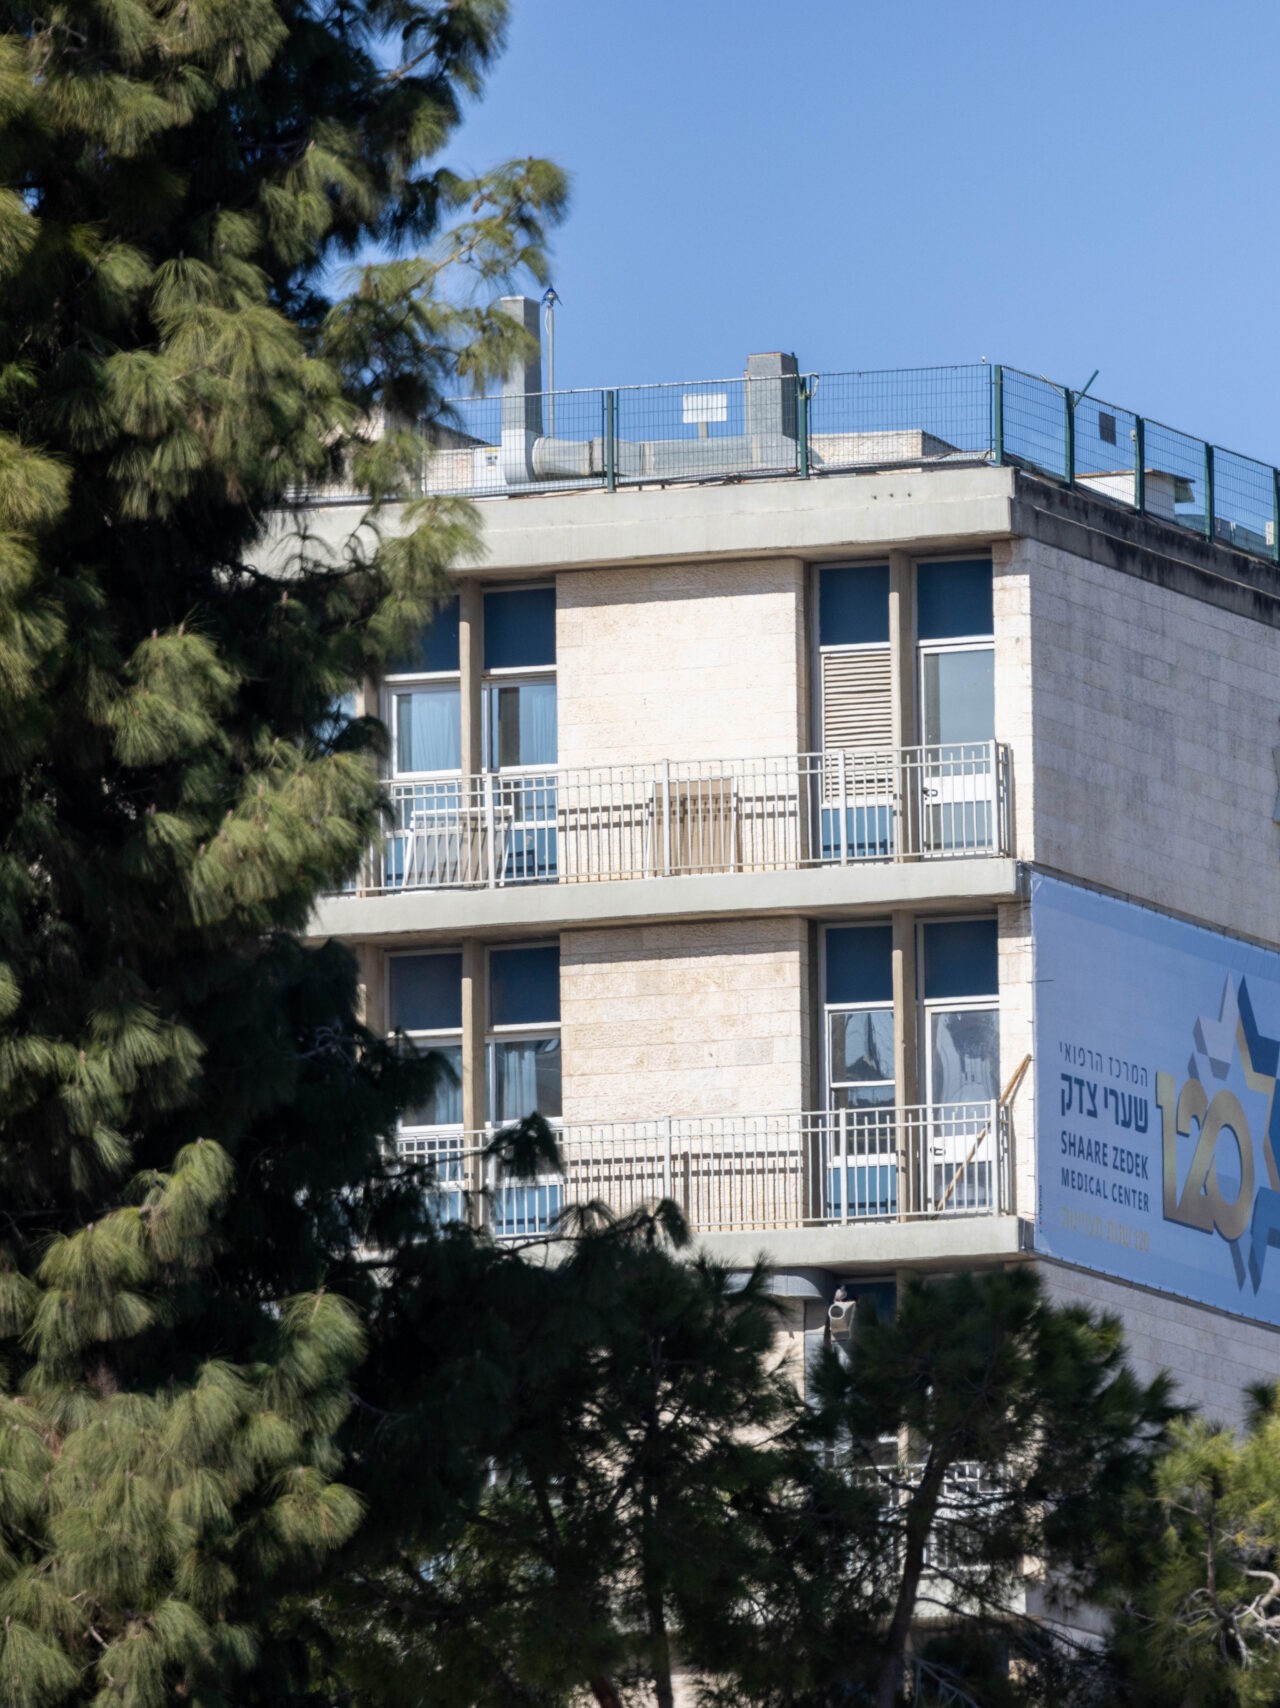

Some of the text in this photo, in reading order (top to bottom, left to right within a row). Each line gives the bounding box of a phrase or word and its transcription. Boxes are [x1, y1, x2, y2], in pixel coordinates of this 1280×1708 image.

[1059, 1041, 1148, 1088] המרכז הרפואי
[1060, 1072, 1149, 1134] שערי צדק
[1060, 1130, 1149, 1180] SHAARE ZEDEK
[1156, 1071, 1254, 1241] 120
[1060, 1166, 1149, 1213] MEDICAL CENTER
